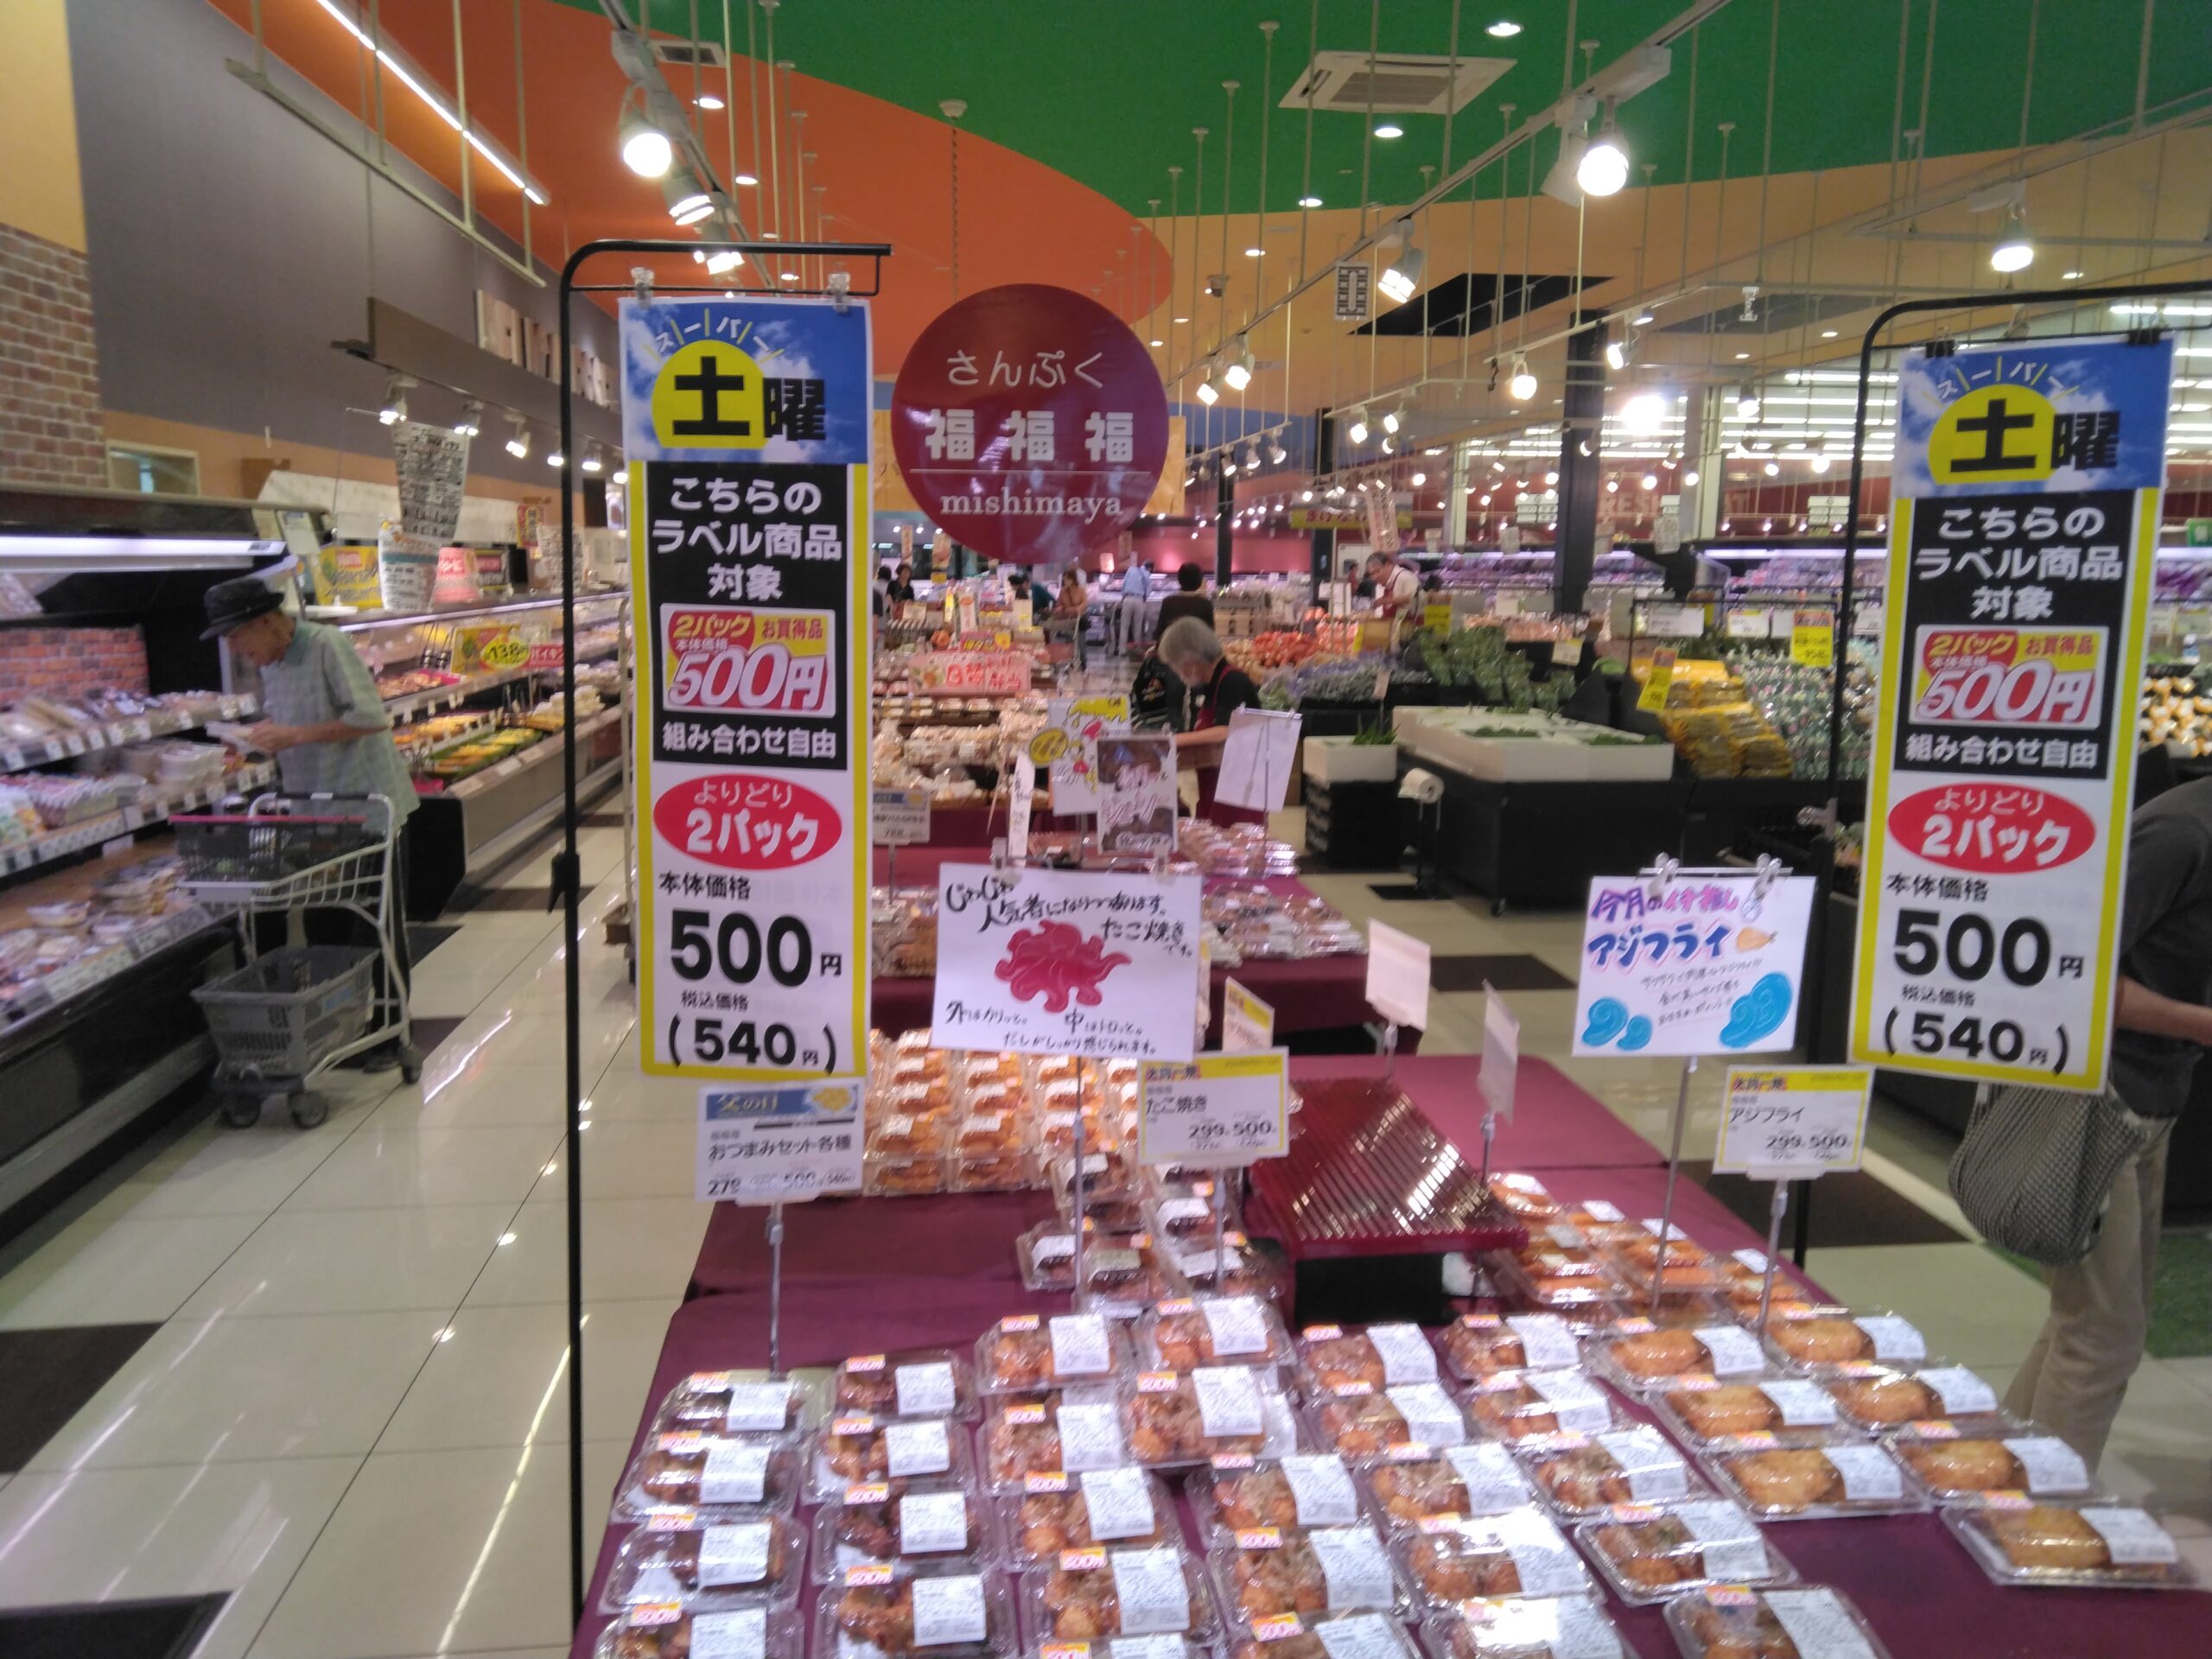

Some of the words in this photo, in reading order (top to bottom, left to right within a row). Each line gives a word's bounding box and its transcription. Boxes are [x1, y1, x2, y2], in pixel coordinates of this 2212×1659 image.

[947, 350, 1103, 388] さんぷく
[672, 355, 827, 442] 土曜
[1950, 398, 2120, 471] 土曜
[671, 477, 822, 515] こちらの
[940, 487, 1122, 524] mishimaya
[652, 519, 842, 561] ラベル商品
[1938, 506, 2105, 541] こちらの
[708, 563, 784, 601] 対象
[1915, 546, 2123, 582] ラベル商品
[1970, 585, 2054, 620] 対象
[673, 613, 750, 638] 2パック
[762, 618, 822, 640] お買得品
[677, 639, 728, 651] 本体価格
[1928, 633, 2014, 657] 2パック
[2025, 635, 2094, 657] お買得品
[670, 643, 826, 709] 500円
[1916, 659, 2094, 721] 500円
[663, 721, 836, 759] 組み合わせ自由
[1905, 733, 2098, 768] 組み合わせ自由
[693, 779, 792, 809] よりどり
[1934, 789, 2044, 815] よりどり
[686, 808, 819, 860] 2パック
[1922, 814, 2070, 866] 2パック
[659, 872, 751, 899] 本体価格
[1887, 874, 1988, 902] 本体価格
[1588, 922, 1730, 967] アジフライ
[682, 990, 748, 1011] 税込価格
[1902, 985, 1975, 1007] 税込価格
[1729, 1106, 1805, 1123] アジフライ
